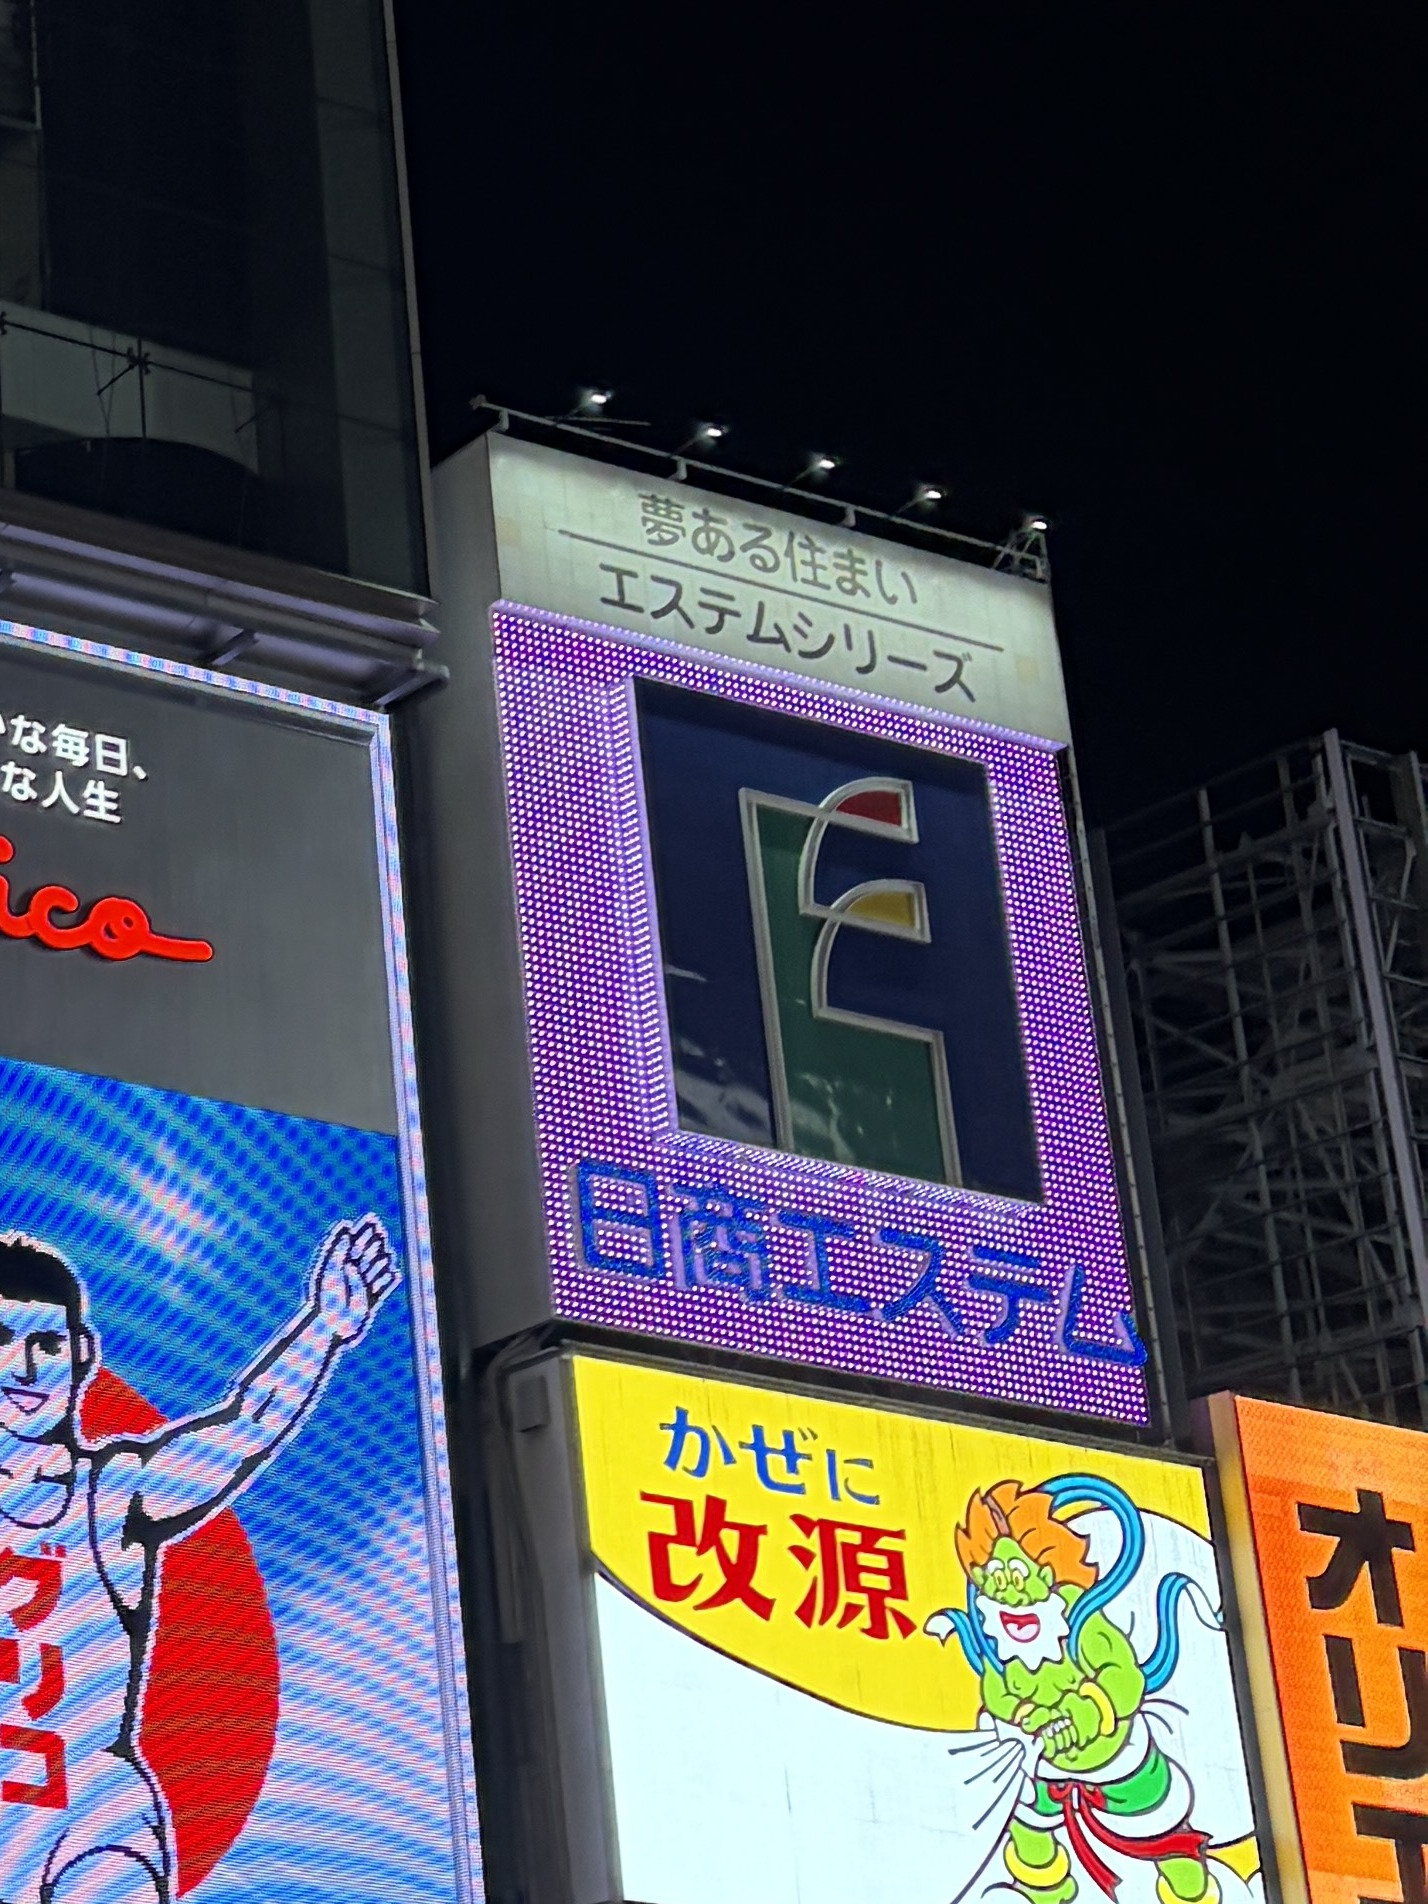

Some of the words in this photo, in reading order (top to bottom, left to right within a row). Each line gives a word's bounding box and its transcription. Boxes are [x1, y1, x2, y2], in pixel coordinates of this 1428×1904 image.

[638, 491, 919, 607] 夢ある住まい
[599, 562, 977, 703] エステムシリーズ
[571, 1159, 1148, 1367] 日商エステム
[660, 1404, 882, 1507] かぜに
[639, 1490, 919, 1642] 改源
